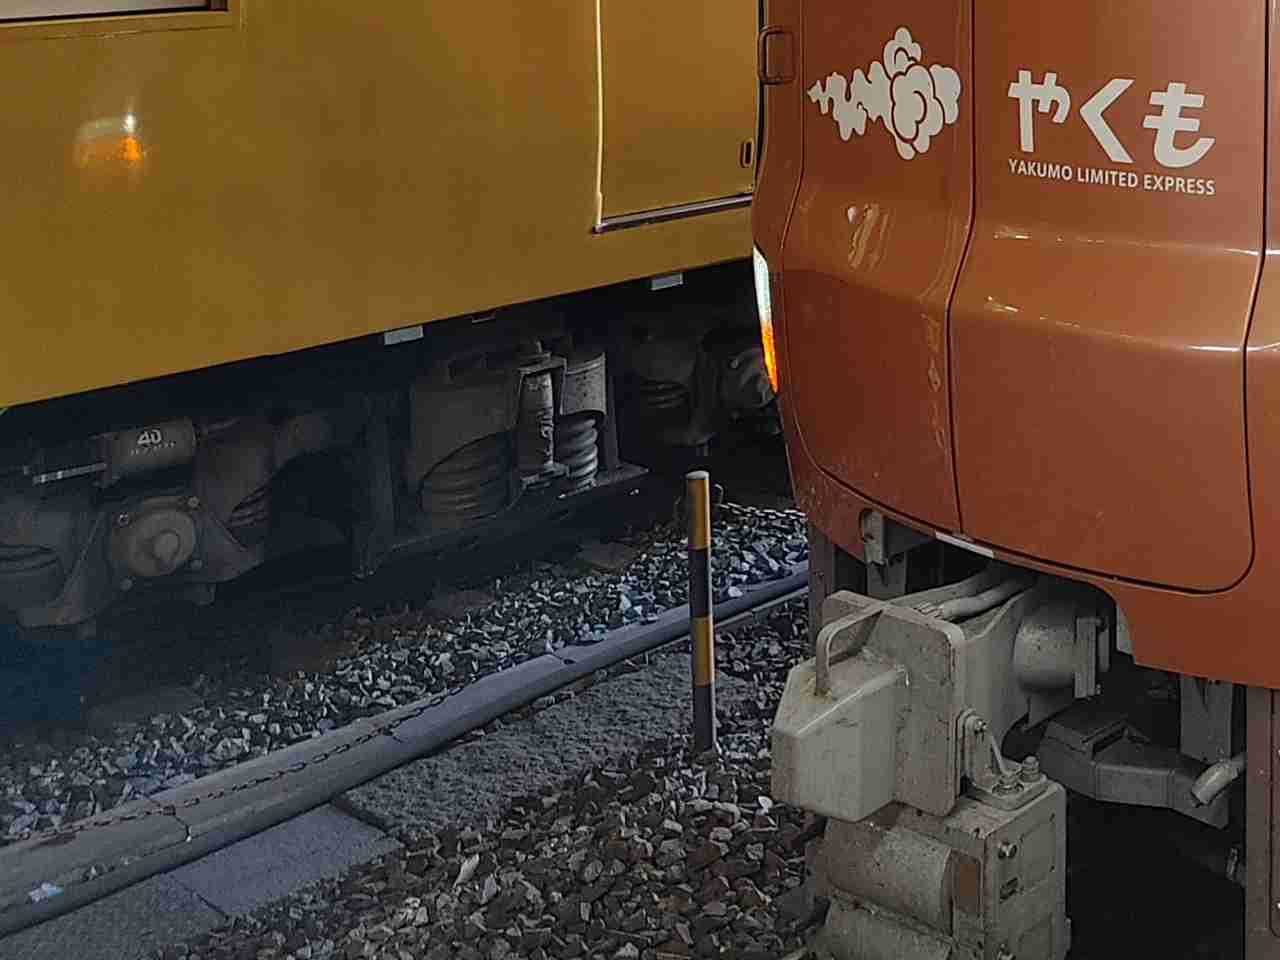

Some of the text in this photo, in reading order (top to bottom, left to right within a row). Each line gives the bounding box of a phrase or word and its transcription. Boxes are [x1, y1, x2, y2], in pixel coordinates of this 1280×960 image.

[1007, 70, 1216, 168] やくも
[1008, 158, 1216, 196] YAKUMO LIMITED EXPRESS
